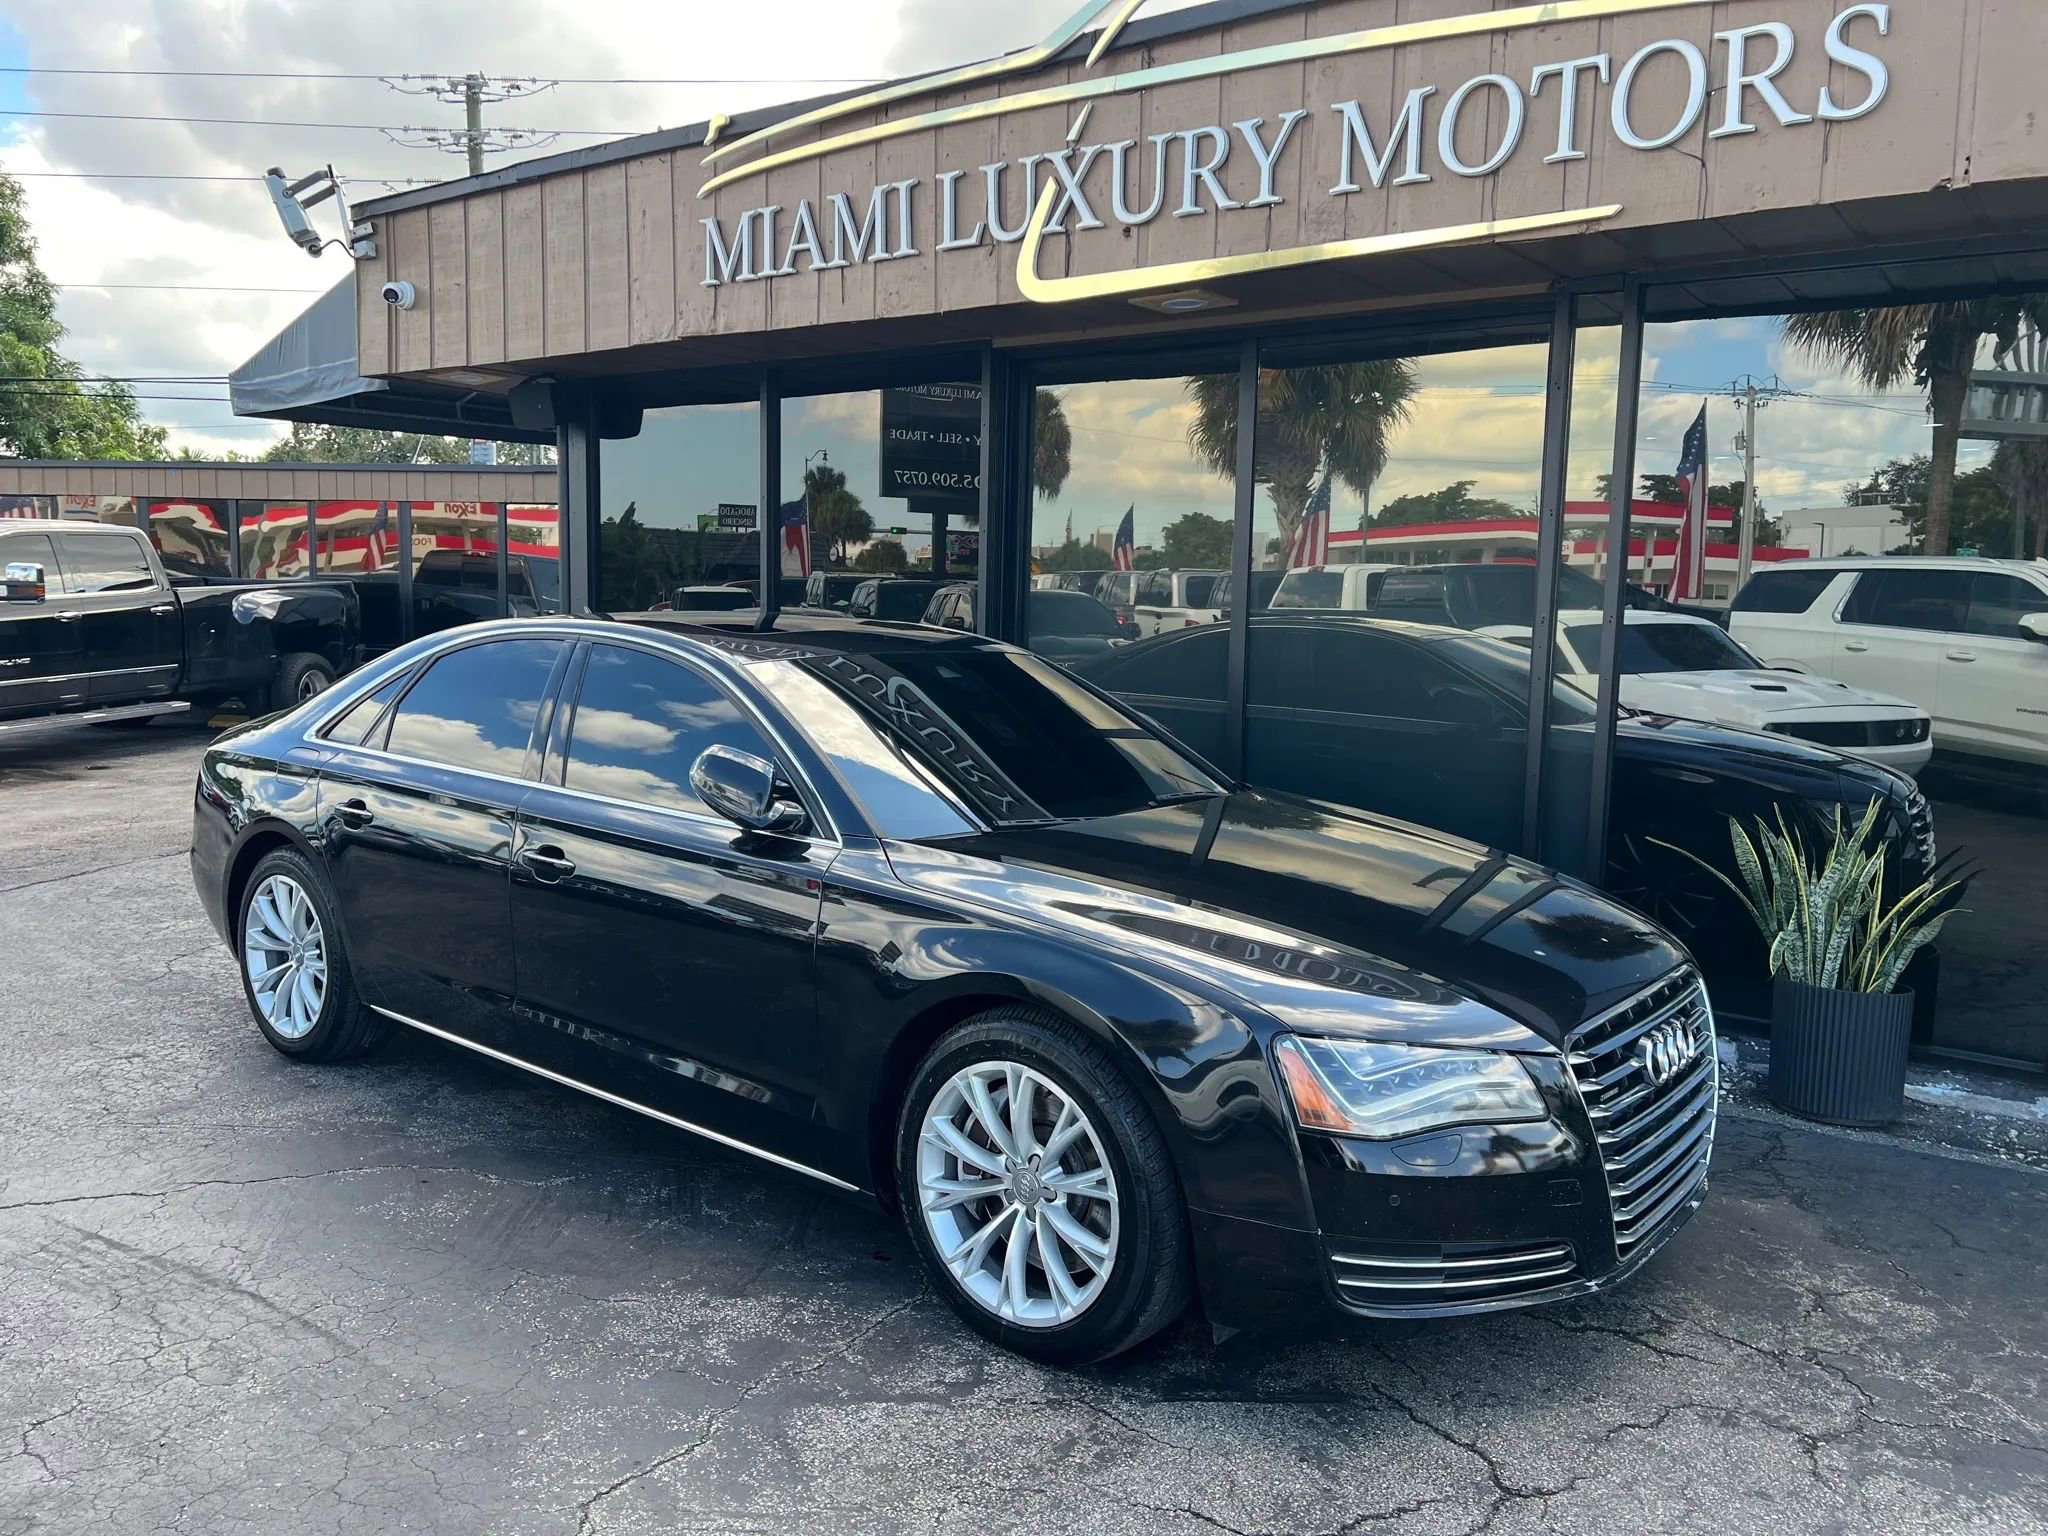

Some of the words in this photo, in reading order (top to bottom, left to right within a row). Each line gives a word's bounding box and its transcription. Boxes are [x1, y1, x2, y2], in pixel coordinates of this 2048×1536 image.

[699, 177, 921, 288] MIAMI
[936, 107, 1308, 253] LUXURY
[1328, 3, 1890, 197] MOTORS
